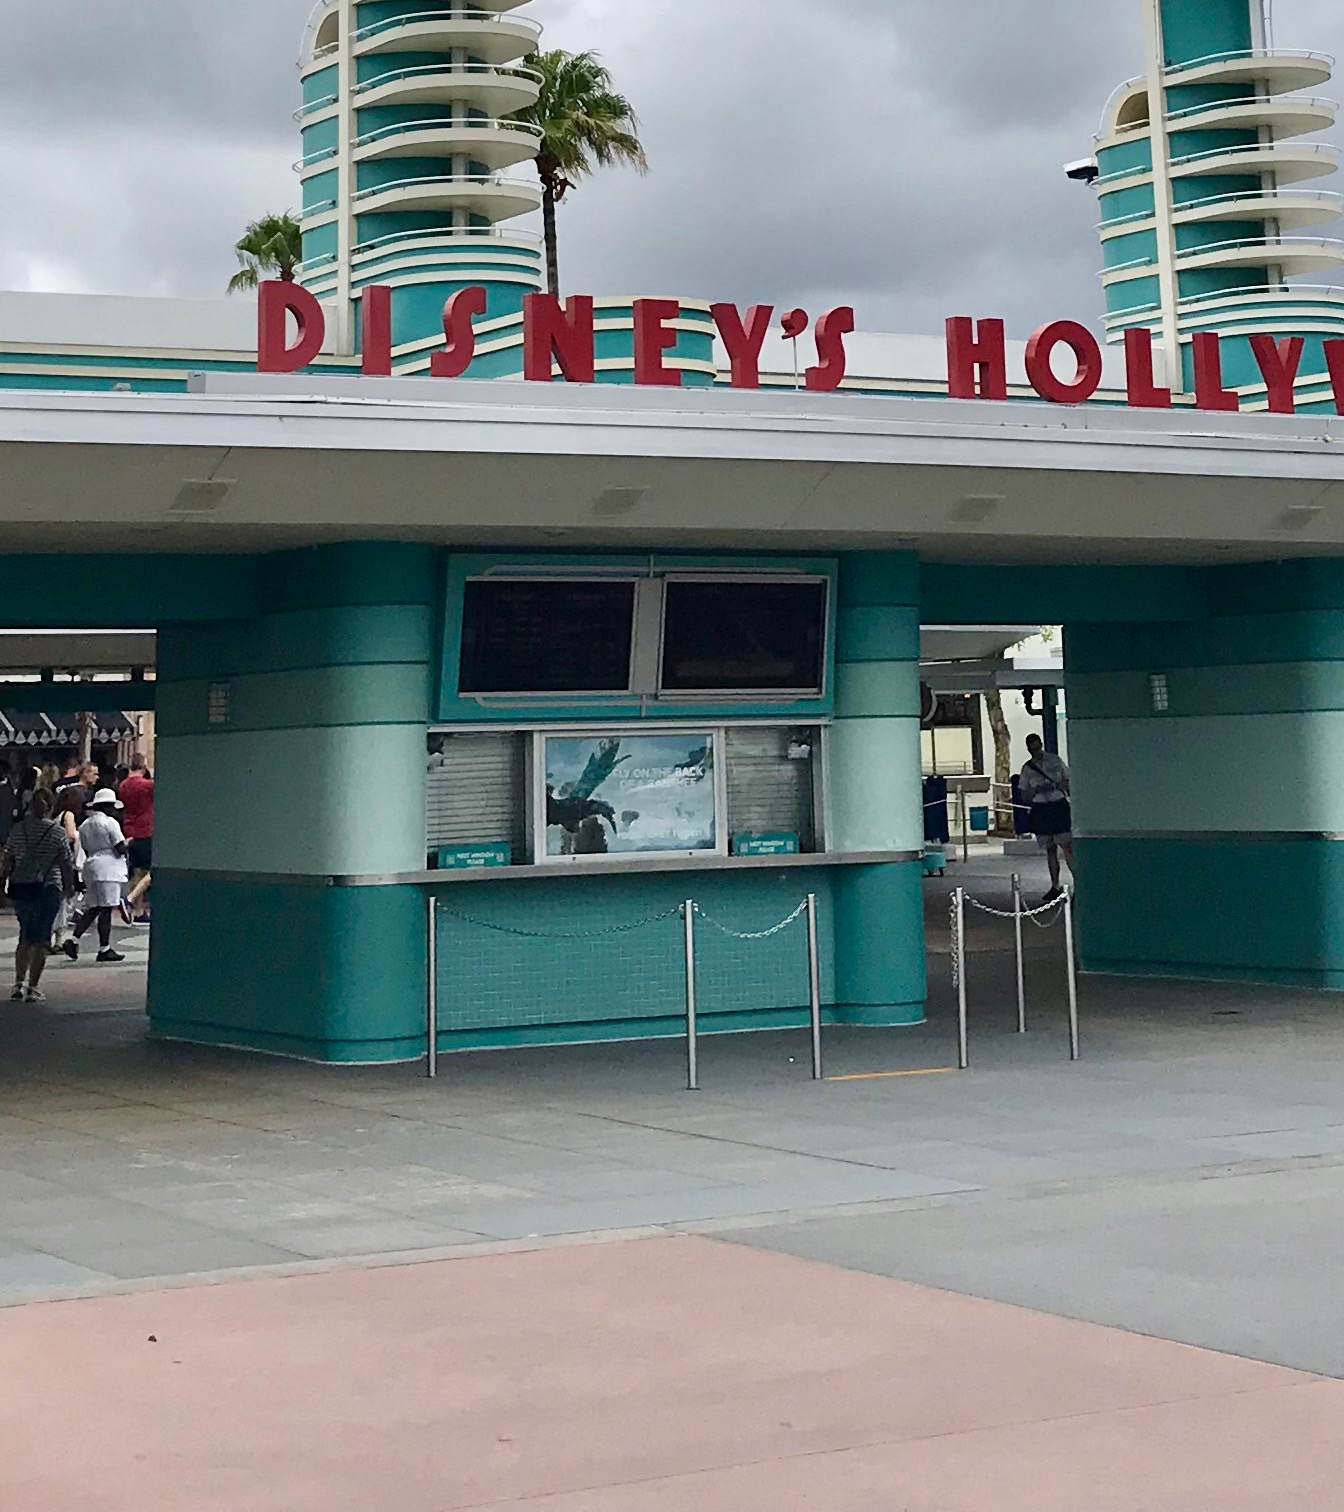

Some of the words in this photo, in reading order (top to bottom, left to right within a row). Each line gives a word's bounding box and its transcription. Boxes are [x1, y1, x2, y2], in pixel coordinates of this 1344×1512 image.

[258, 280, 854, 392] DISNEY'S
[632, 768, 651, 778] ON
[675, 766, 704, 777] BACK
